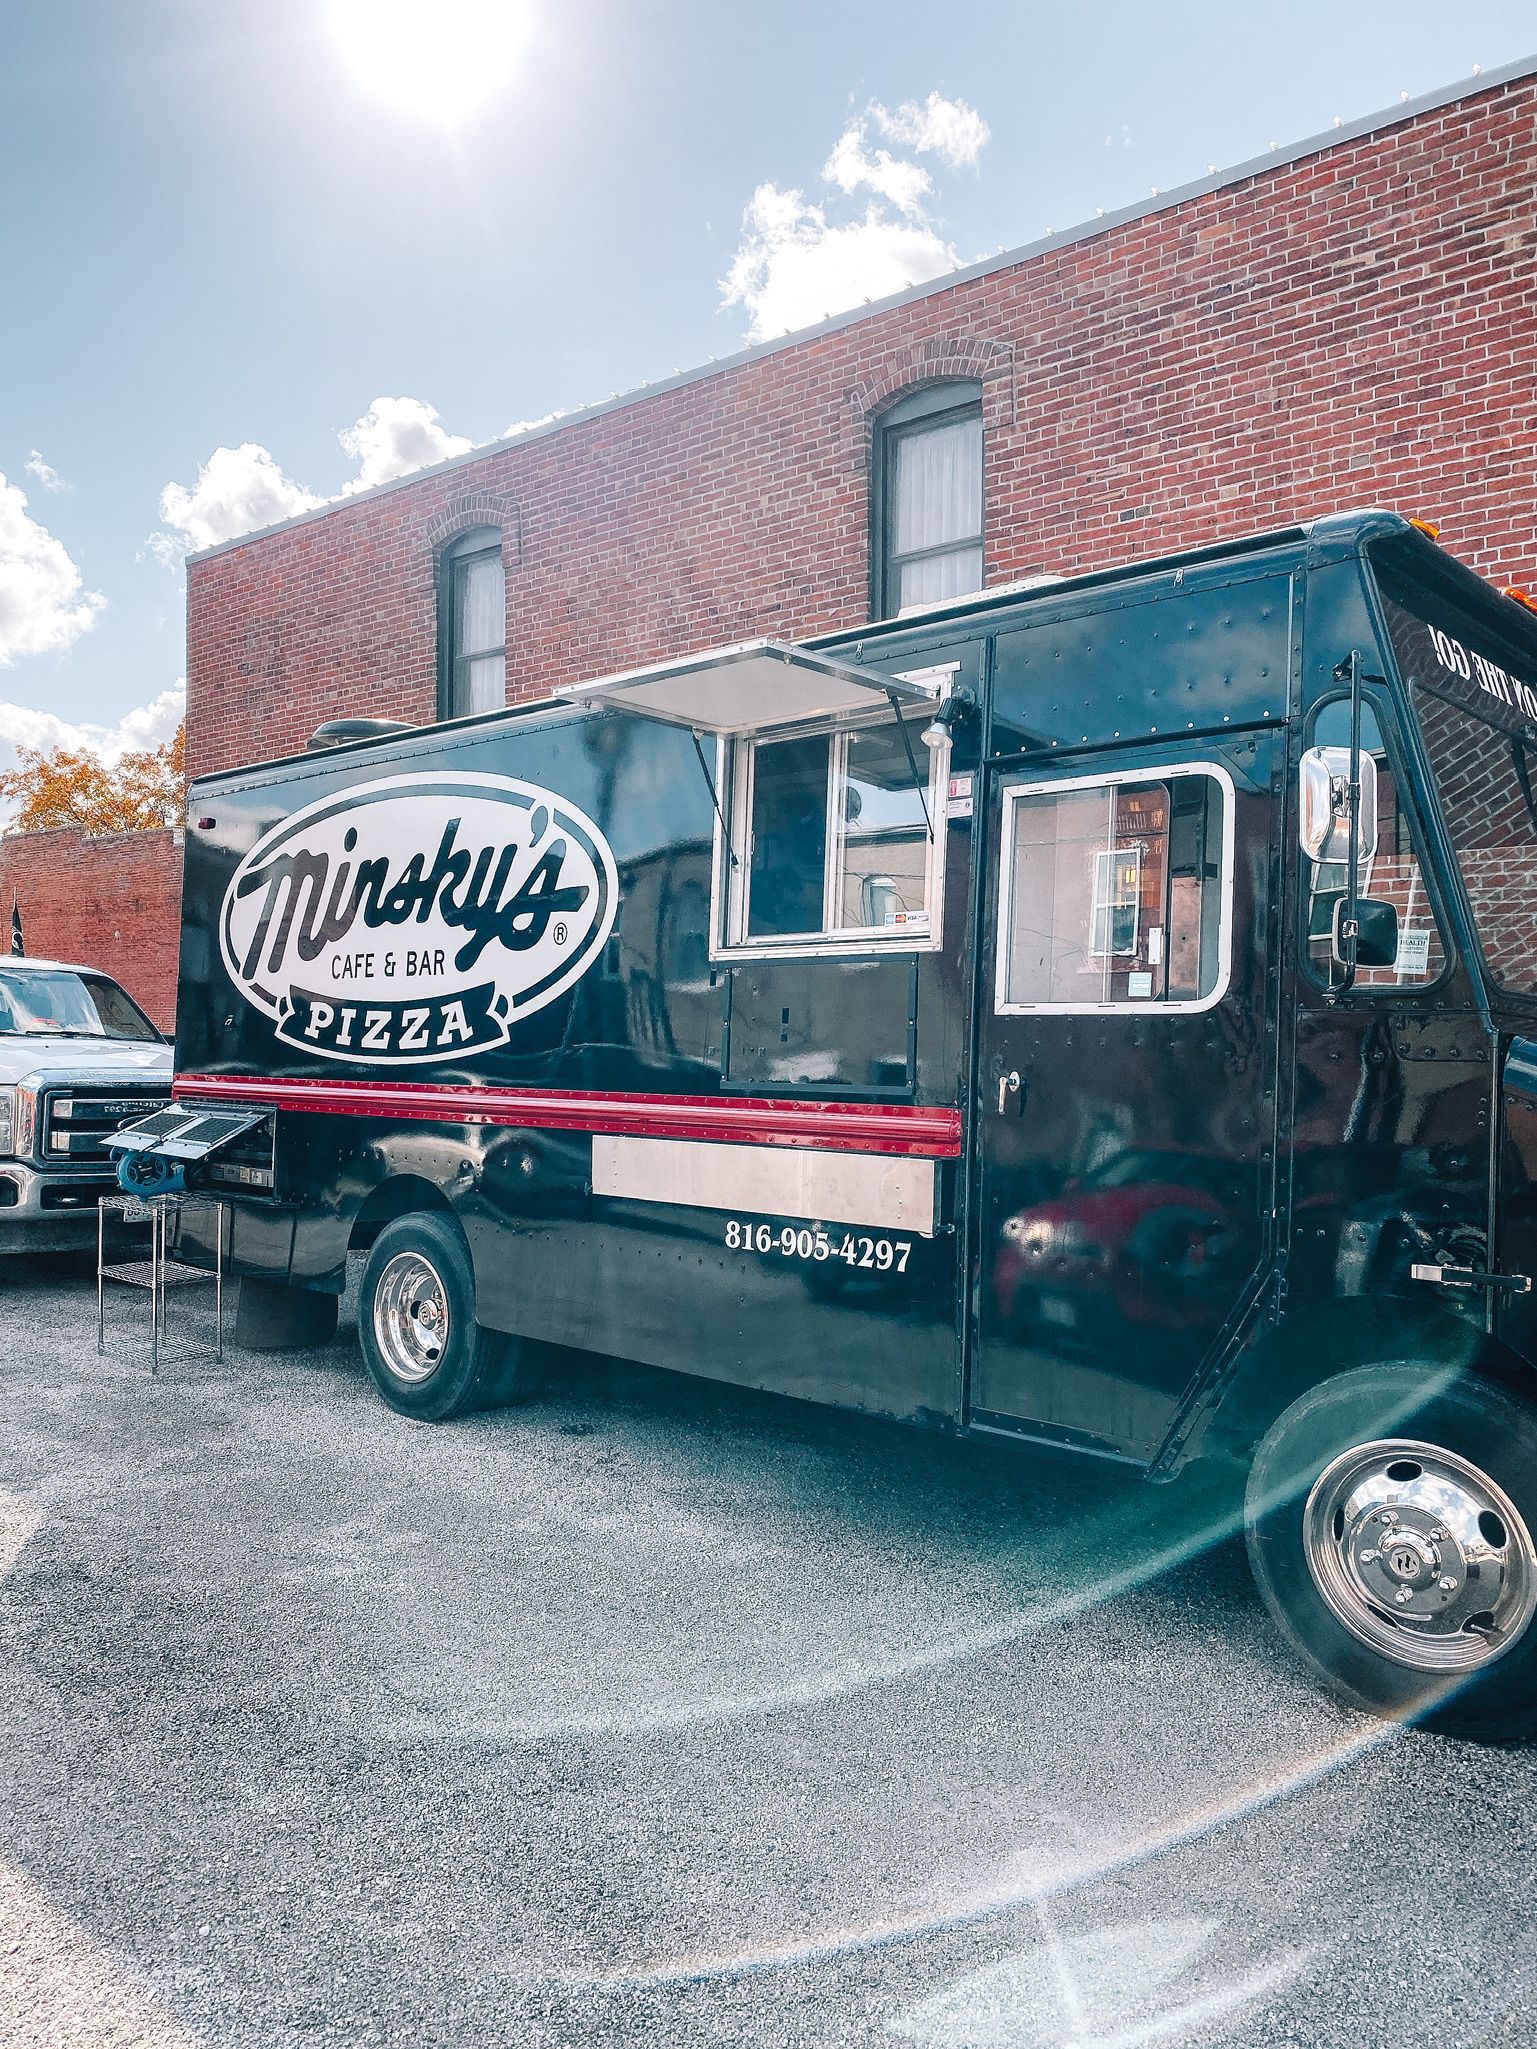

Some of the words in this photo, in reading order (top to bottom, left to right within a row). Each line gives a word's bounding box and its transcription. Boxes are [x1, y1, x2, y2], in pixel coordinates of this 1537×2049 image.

[237, 806, 590, 980] Minsky's
[332, 953, 375, 979] CAFE
[384, 952, 396, 977] &
[405, 949, 445, 977] BAR
[304, 1000, 475, 1050] PIZZA
[725, 1220, 912, 1272] 816-905-4297
